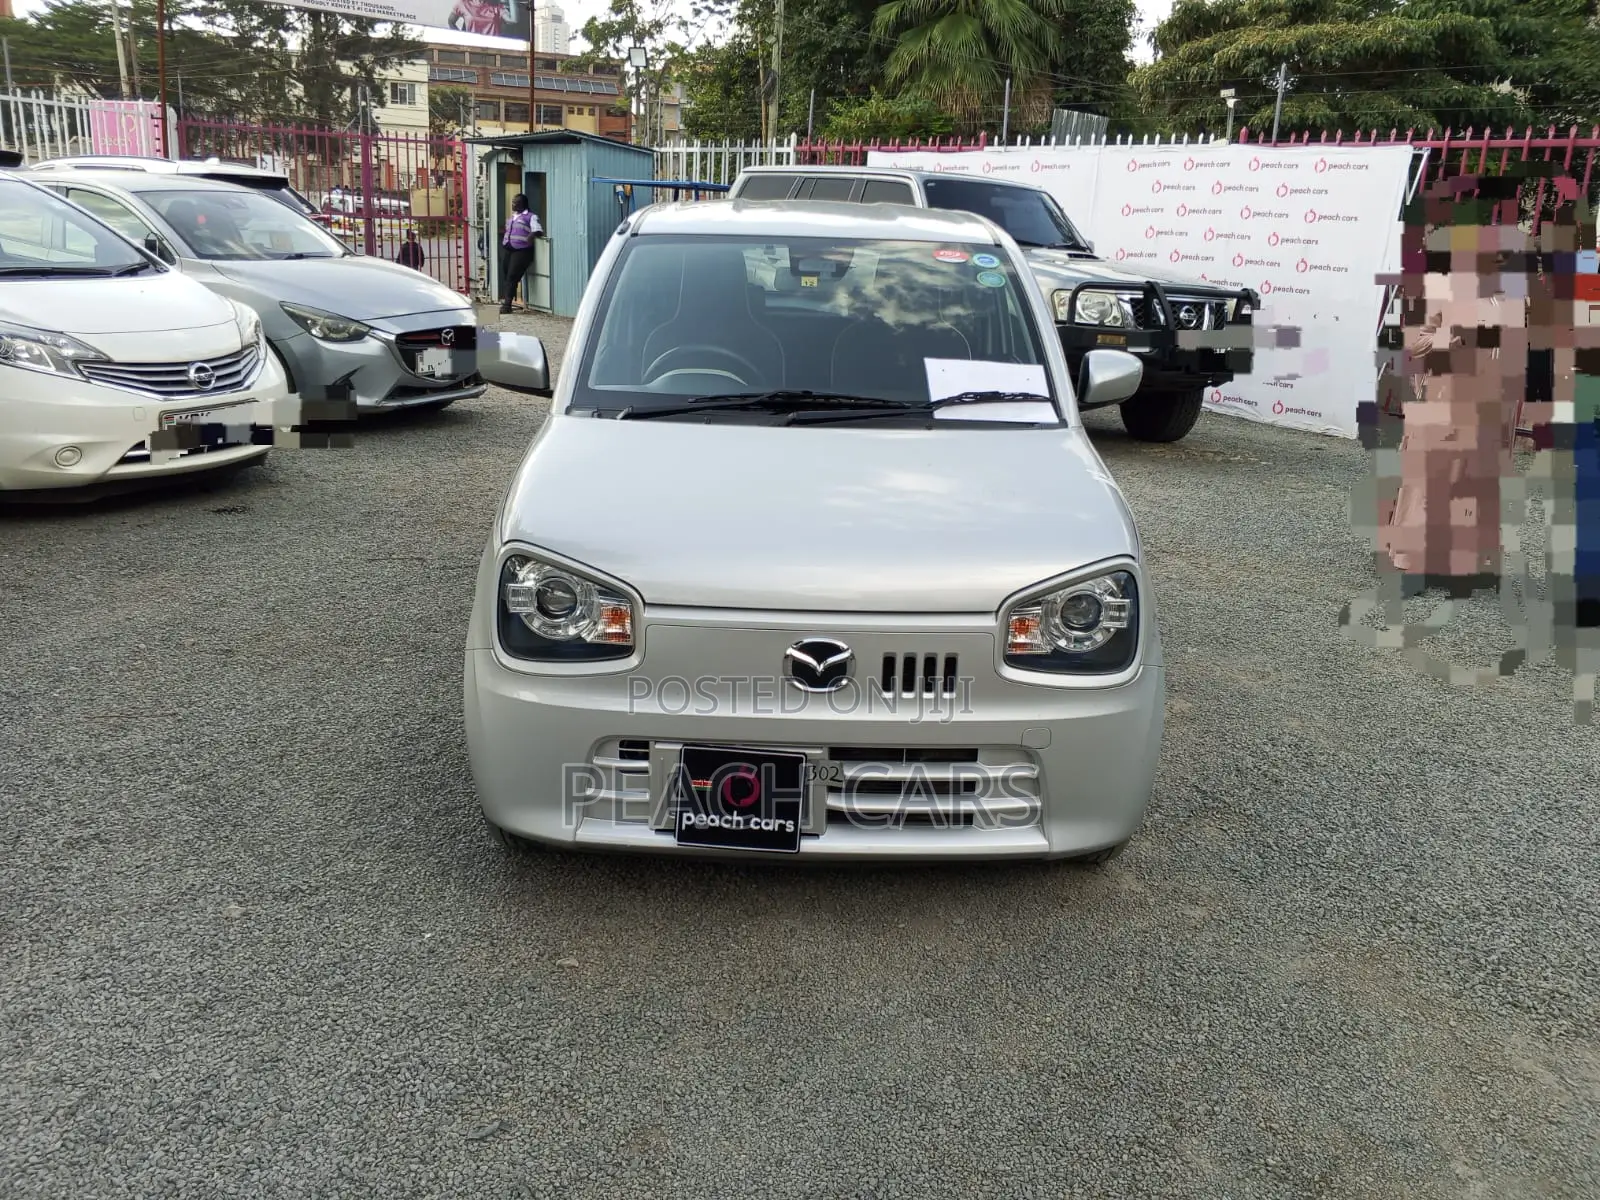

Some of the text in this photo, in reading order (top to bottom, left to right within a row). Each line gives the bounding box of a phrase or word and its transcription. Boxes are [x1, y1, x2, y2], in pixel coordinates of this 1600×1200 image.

[377, 9, 417, 20] MARKETPLACE
[1138, 161, 1156, 170] peach
[1195, 161, 1215, 170] peach
[1261, 162, 1282, 170] peach
[1328, 162, 1351, 171] peach
[1224, 184, 1244, 192] peach
[1290, 187, 1311, 196] peach
[1132, 206, 1150, 214] peach
[1188, 208, 1207, 216] peach
[1252, 210, 1273, 218] peach
[1318, 212, 1358, 222] peach cars
[1156, 228, 1174, 237] peach
[1216, 232, 1235, 240] peach
[1280, 236, 1301, 245] peach
[1126, 251, 1144, 259] peach
[1181, 254, 1200, 262] peach
[1245, 258, 1265, 266] peach
[1309, 263, 1331, 272] peach
[1273, 285, 1294, 293] peach
[1285, 406, 1322, 418] peach cars
[807, 765, 844, 783] 302
[682, 810, 795, 833] peach cars
